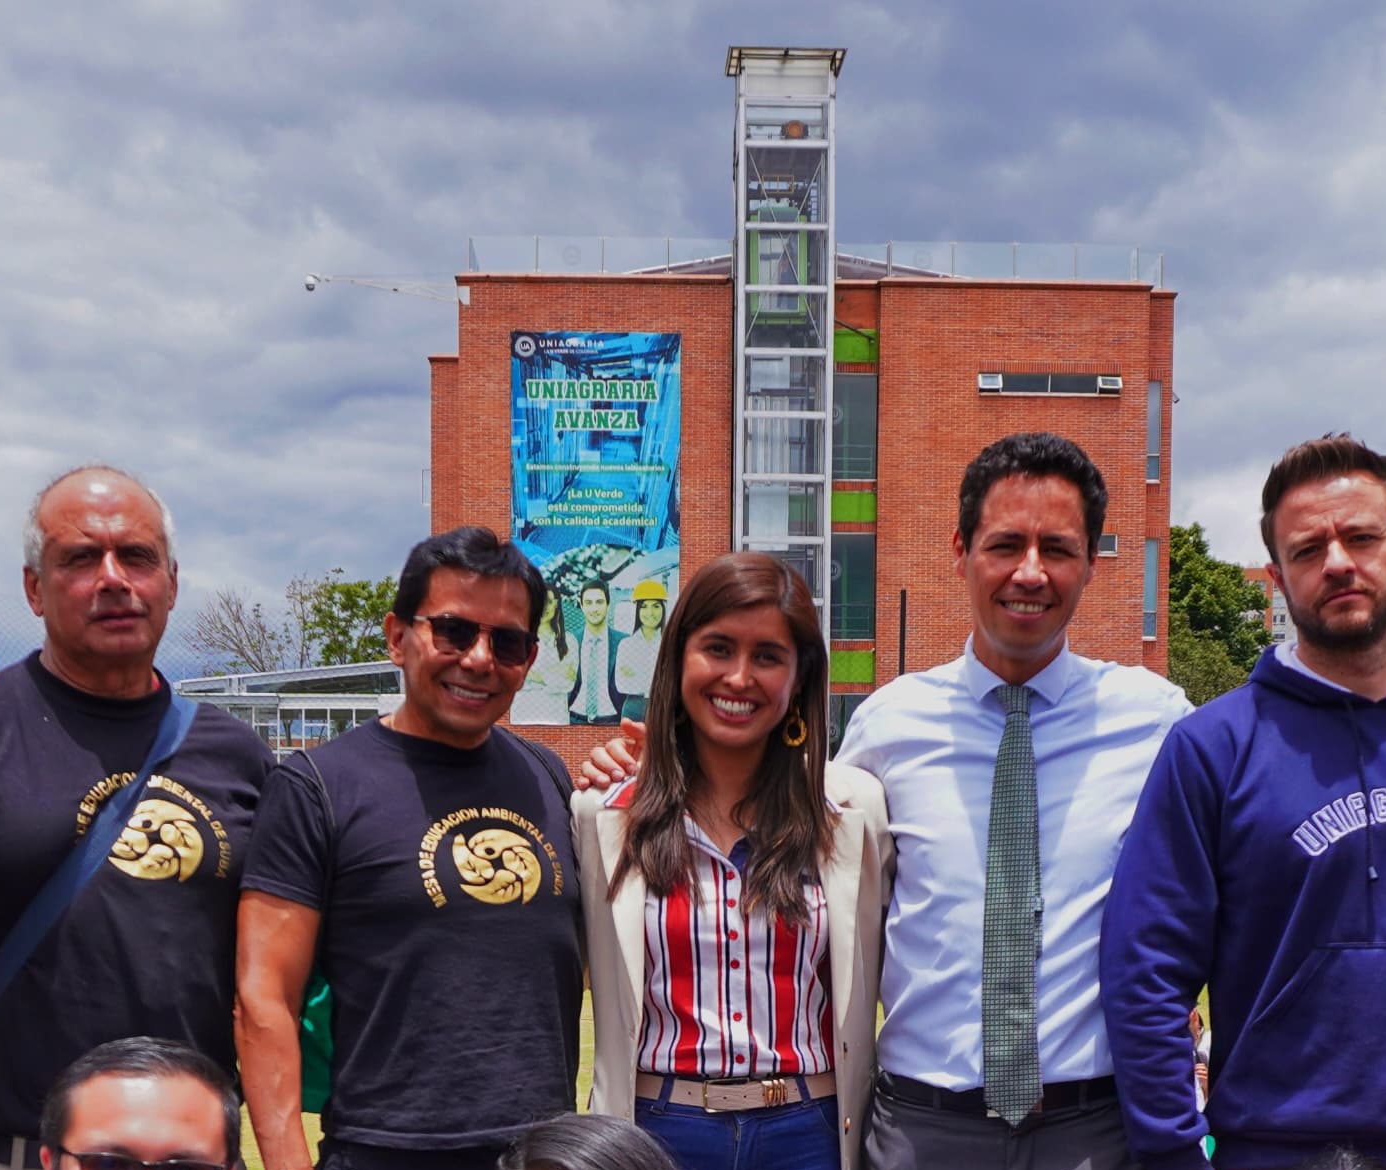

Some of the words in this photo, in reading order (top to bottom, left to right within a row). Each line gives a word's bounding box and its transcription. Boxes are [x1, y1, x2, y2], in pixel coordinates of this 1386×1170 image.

[527, 380, 658, 400] UNIAGRARIA
[554, 410, 638, 430] AVANZA
[585, 489, 592, 498] U
[593, 489, 623, 498] Verde
[548, 502, 568, 512] está
[570, 503, 643, 514] comprometida
[533, 518, 551, 526] con
[553, 516, 562, 526] la
[564, 516, 600, 526] calidad
[602, 516, 657, 526] académica!
[80, 771, 137, 816] EDUCACIO
[147, 774, 213, 821] MBIENTAL
[420, 807, 480, 852] EDUCACION
[481, 807, 545, 845] AMBIENTAL
[418, 851, 435, 870] DE
[543, 842, 558, 861] DE
